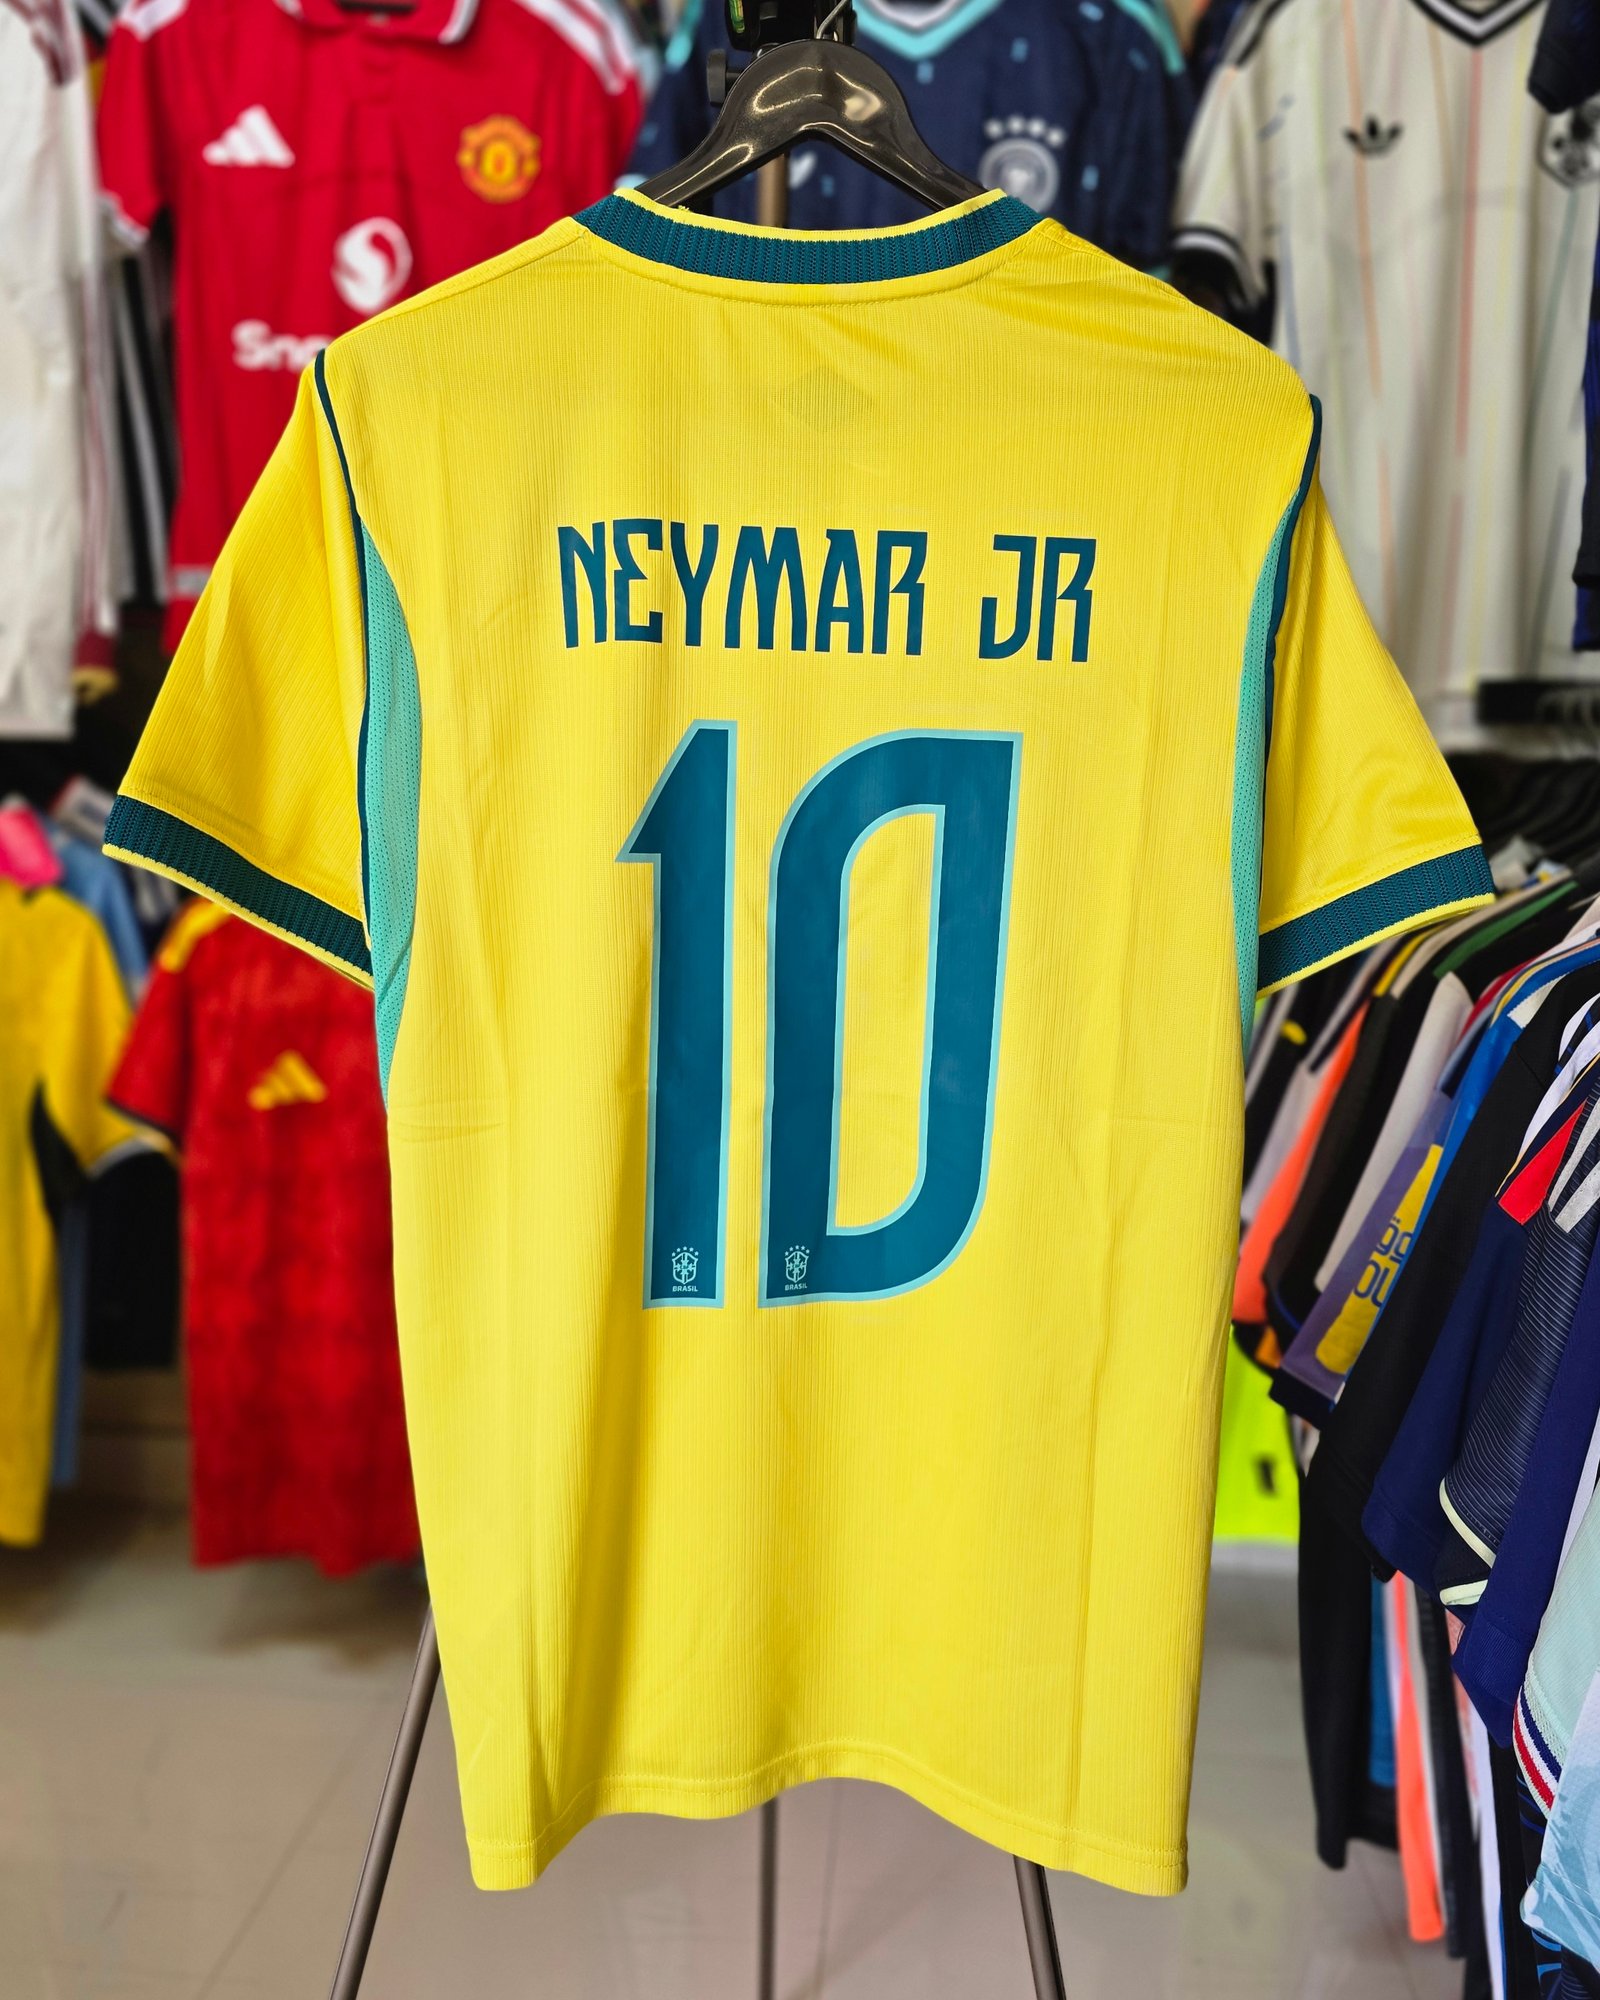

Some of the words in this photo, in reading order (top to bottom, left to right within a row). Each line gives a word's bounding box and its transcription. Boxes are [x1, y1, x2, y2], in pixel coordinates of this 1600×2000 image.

[557, 518, 928, 656] NEYMAR
[978, 534, 1097, 663] JR
[614, 719, 1024, 1309] 10
[784, 1283, 808, 1291] BRASIL
